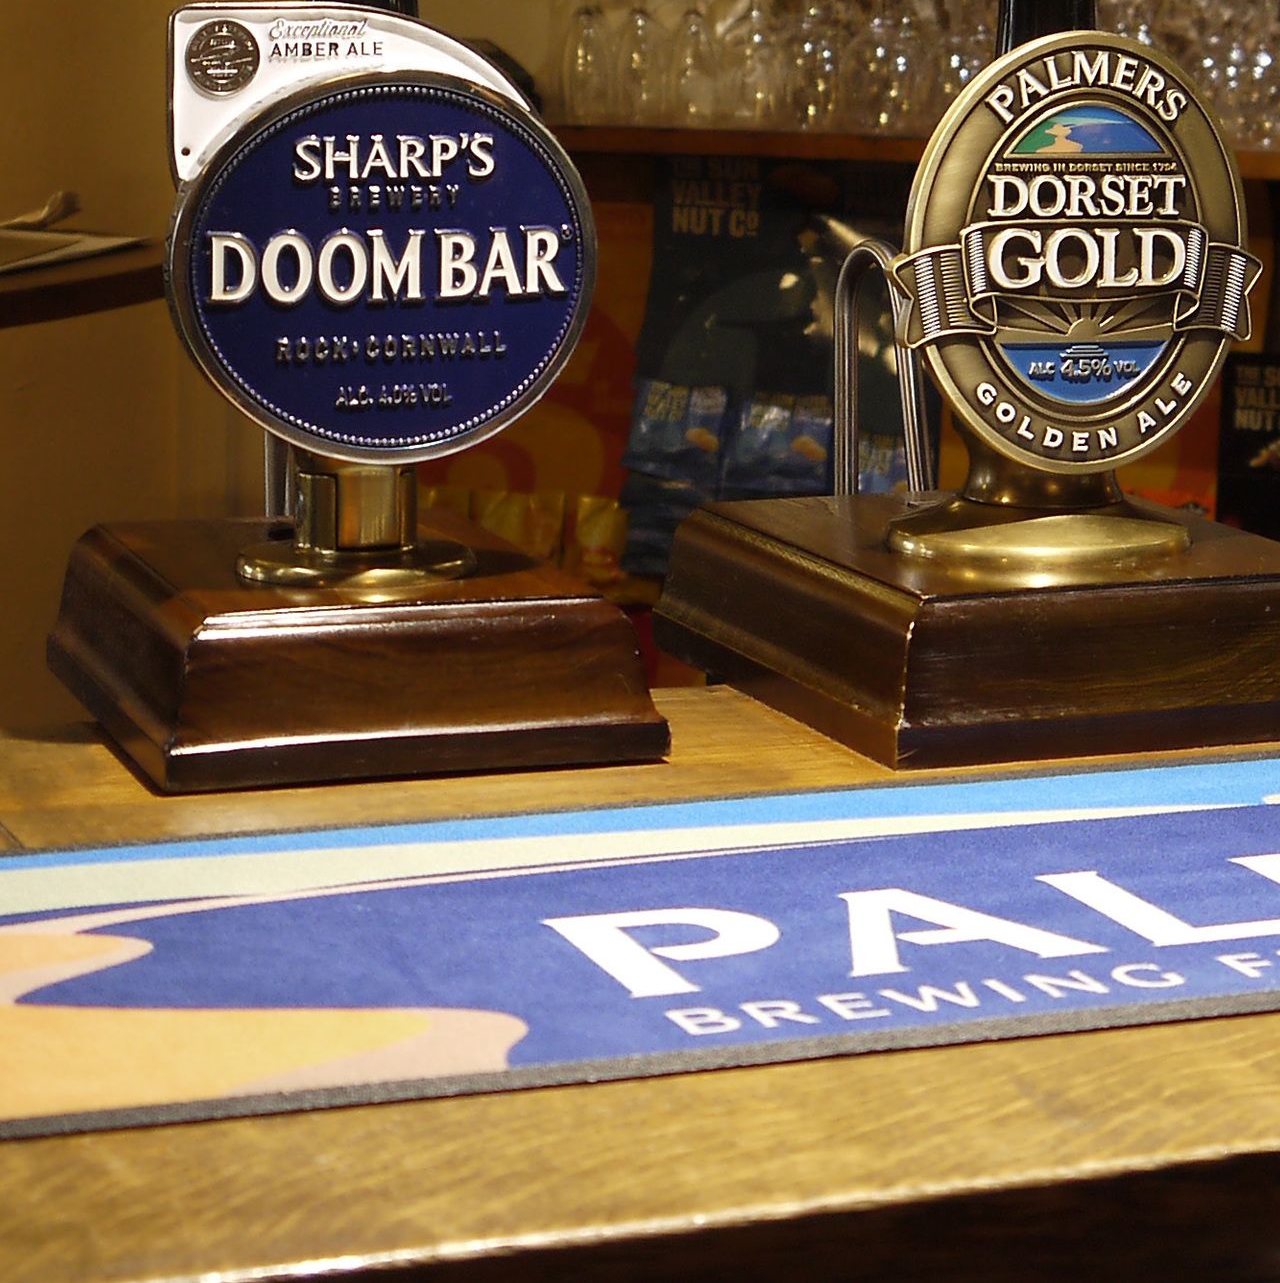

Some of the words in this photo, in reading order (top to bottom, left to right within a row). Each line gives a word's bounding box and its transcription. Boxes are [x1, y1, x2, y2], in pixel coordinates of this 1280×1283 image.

[269, 18, 368, 41] Exceptional
[270, 41, 339, 58] AMBER
[346, 41, 384, 57] ALE
[984, 50, 1190, 125] PALMERS
[293, 131, 496, 182] SHARP'S
[994, 162, 1050, 173] BREWING
[1053, 162, 1066, 172] IN
[1068, 162, 1114, 172] DORSET
[1115, 162, 1150, 172] SINCE
[329, 184, 460, 209] BREWERY
[671, 179, 761, 208] VALLEY
[986, 173, 1187, 218] DORSET
[671, 206, 724, 237] NUT
[205, 228, 426, 306] DOOM
[433, 225, 570, 299] BAR
[987, 227, 1187, 290] GOLD
[1028, 361, 1056, 376] ALC
[1060, 358, 1112, 378] 4.5%
[1113, 359, 1143, 375] VOL
[976, 381, 1118, 452] GOLDEN
[1136, 372, 1193, 434] ALE
[1234, 408, 1274, 432] NUT
[663, 961, 1187, 1037] BREWING
